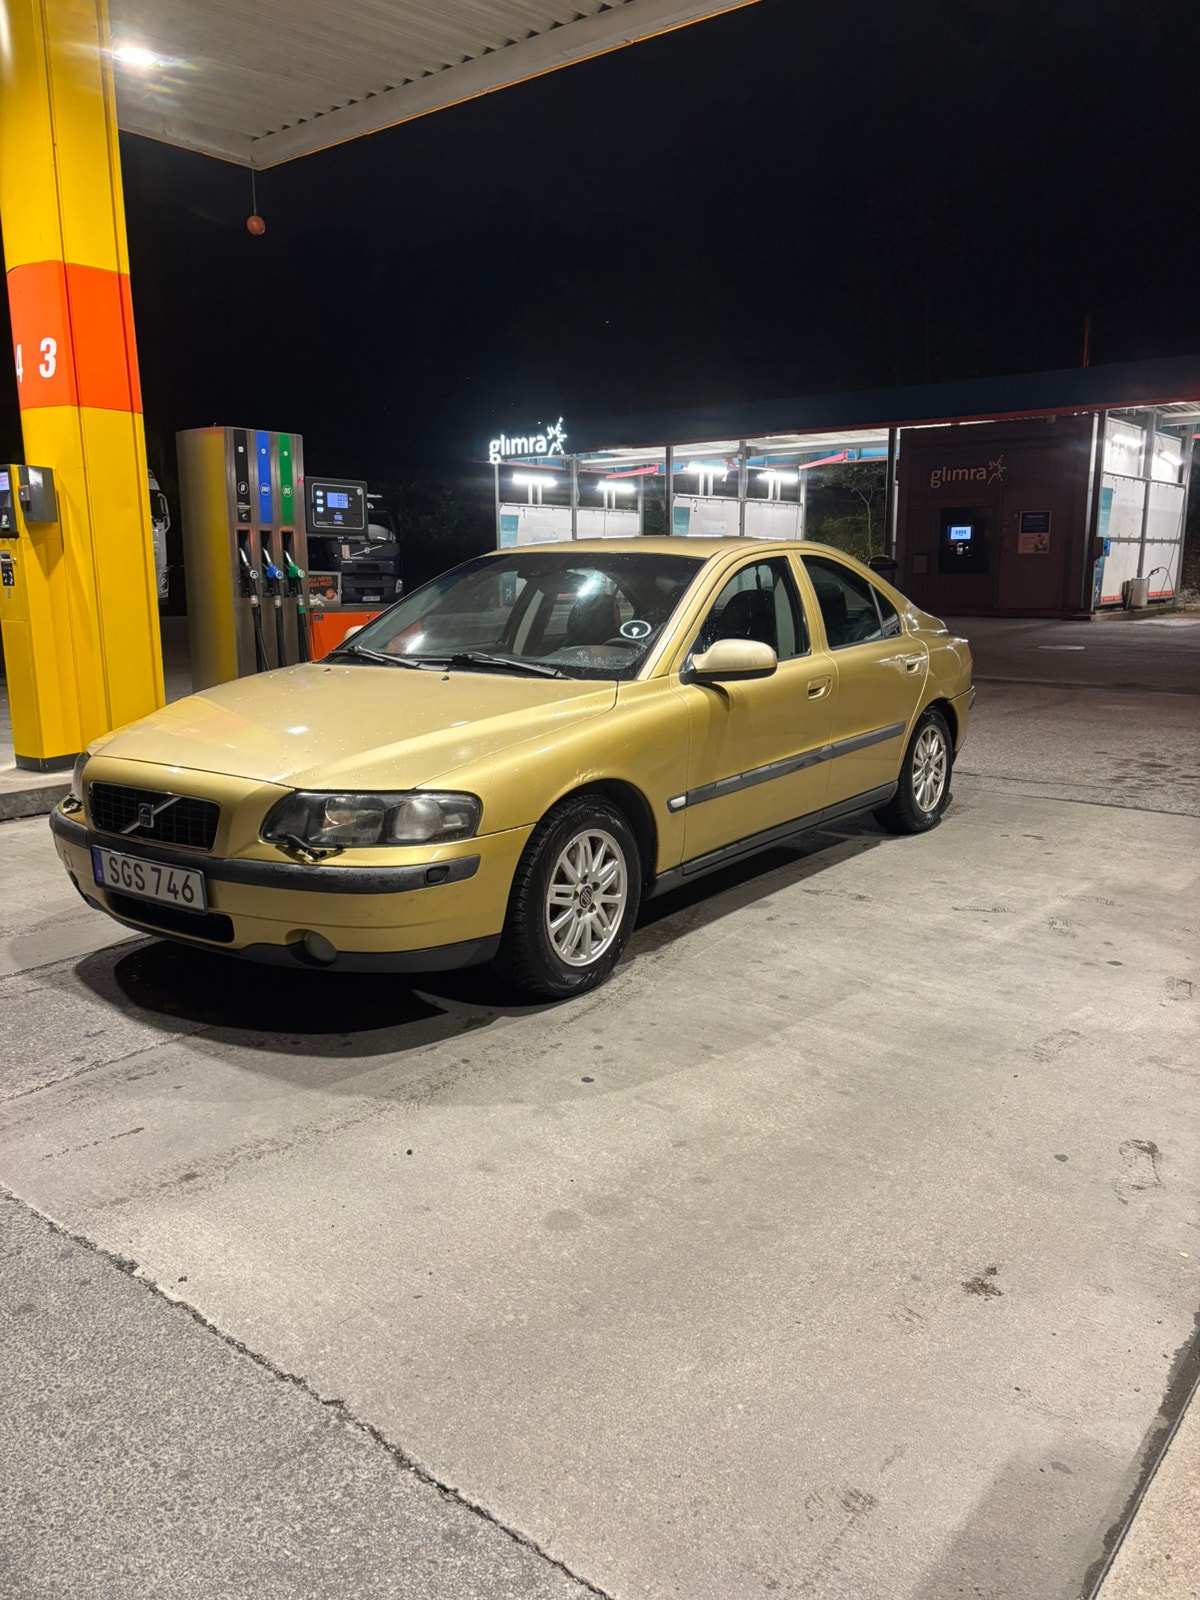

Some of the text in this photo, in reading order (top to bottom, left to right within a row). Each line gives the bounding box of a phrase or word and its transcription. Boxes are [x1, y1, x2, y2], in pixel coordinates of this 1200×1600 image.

[39, 337, 58, 379] 3
[488, 434, 548, 464] glimra
[930, 466, 987, 488] glimra
[693, 499, 699, 513] 2
[109, 857, 194, 903] SGS 746
